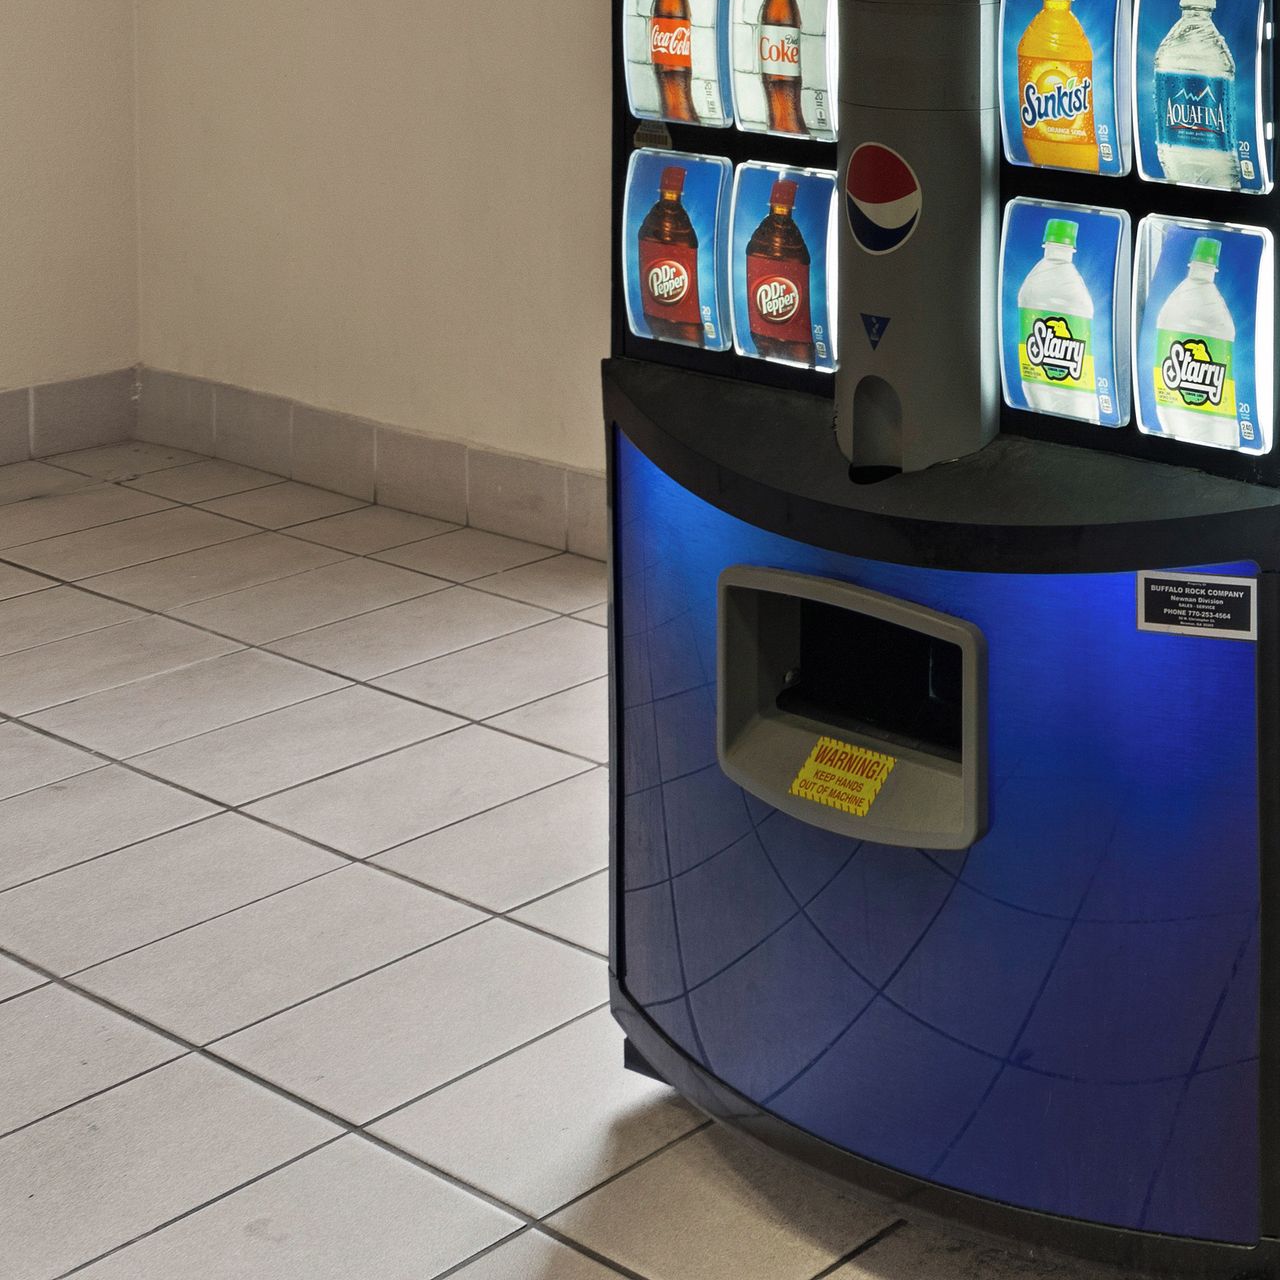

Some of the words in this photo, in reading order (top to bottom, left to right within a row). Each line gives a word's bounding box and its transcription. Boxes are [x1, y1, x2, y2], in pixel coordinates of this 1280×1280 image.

[651, 22, 691, 55] Coca-Cola
[759, 36, 799, 65] Coke
[1021, 77, 1091, 128] Sunkist
[1166, 97, 1225, 134] AQUAFINA
[649, 267, 685, 296] Pepper
[662, 263, 677, 280] Dr
[757, 286, 798, 314] Pepper
[772, 282, 786, 299] Dr
[1027, 321, 1085, 378] Starry
[1163, 343, 1226, 404] Starry
[1239, 403, 1250, 413] 20
[1151, 585, 1183, 594] BUFFALO
[1208, 590, 1244, 598] COMPANY
[1171, 595, 1196, 603] Newnan
[1198, 597, 1224, 605] Division
[1163, 608, 1186, 616] PHONE
[1188, 610, 1231, 619] 770-253-4564
[814, 744, 886, 781] WARNING!
[799, 779, 817, 791] OUT
[816, 784, 830, 794] OF
[829, 789, 865, 807] MACHINE
[813, 769, 836, 782] KEEP
[835, 776, 864, 792] HANDS
